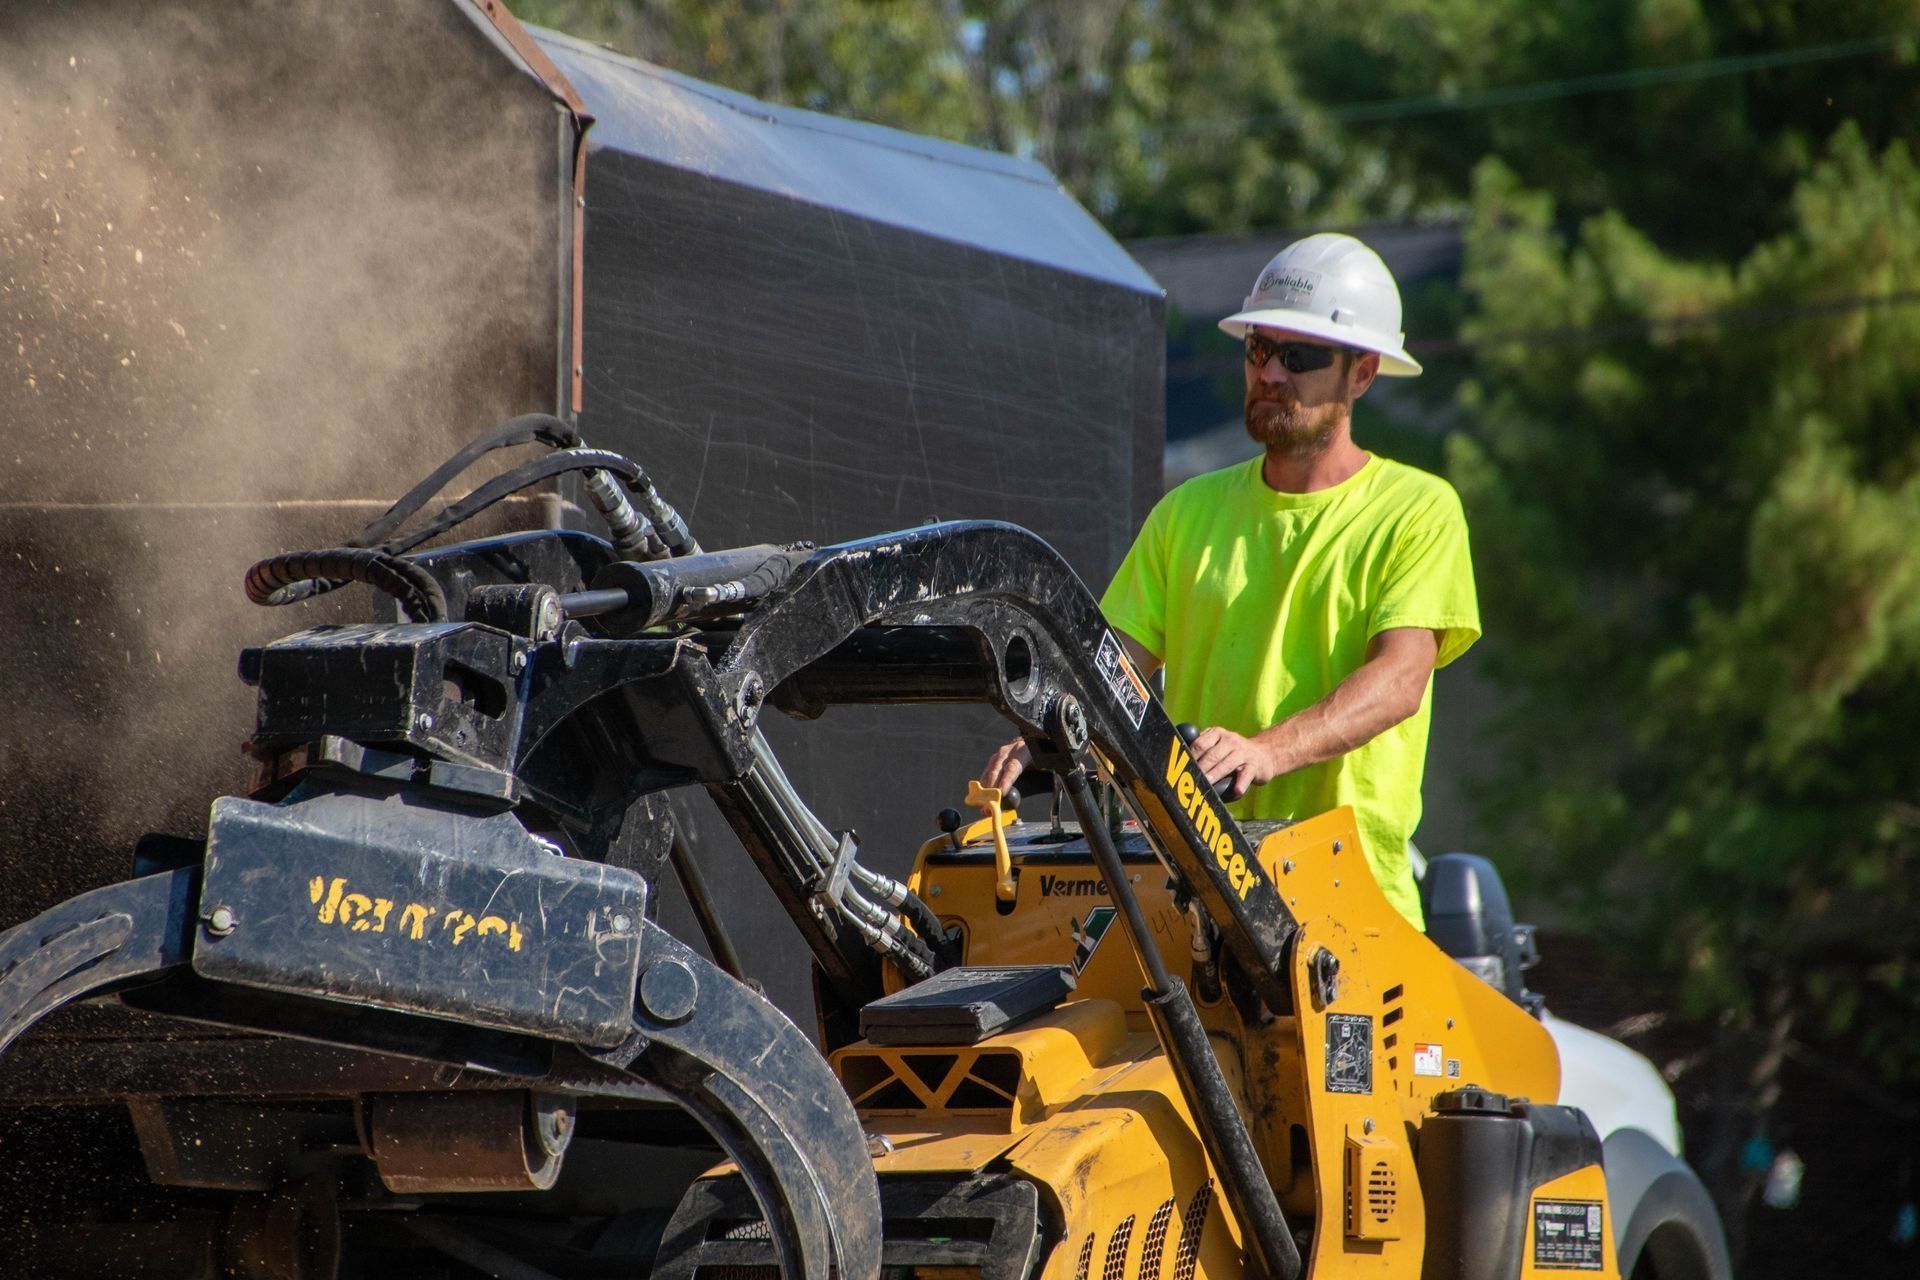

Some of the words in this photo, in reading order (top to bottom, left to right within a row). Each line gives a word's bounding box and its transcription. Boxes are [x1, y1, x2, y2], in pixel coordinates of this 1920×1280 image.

[1274, 275, 1313, 291] reliable
[1166, 735, 1256, 901] Vermeer
[1040, 875, 1133, 897] Verme
